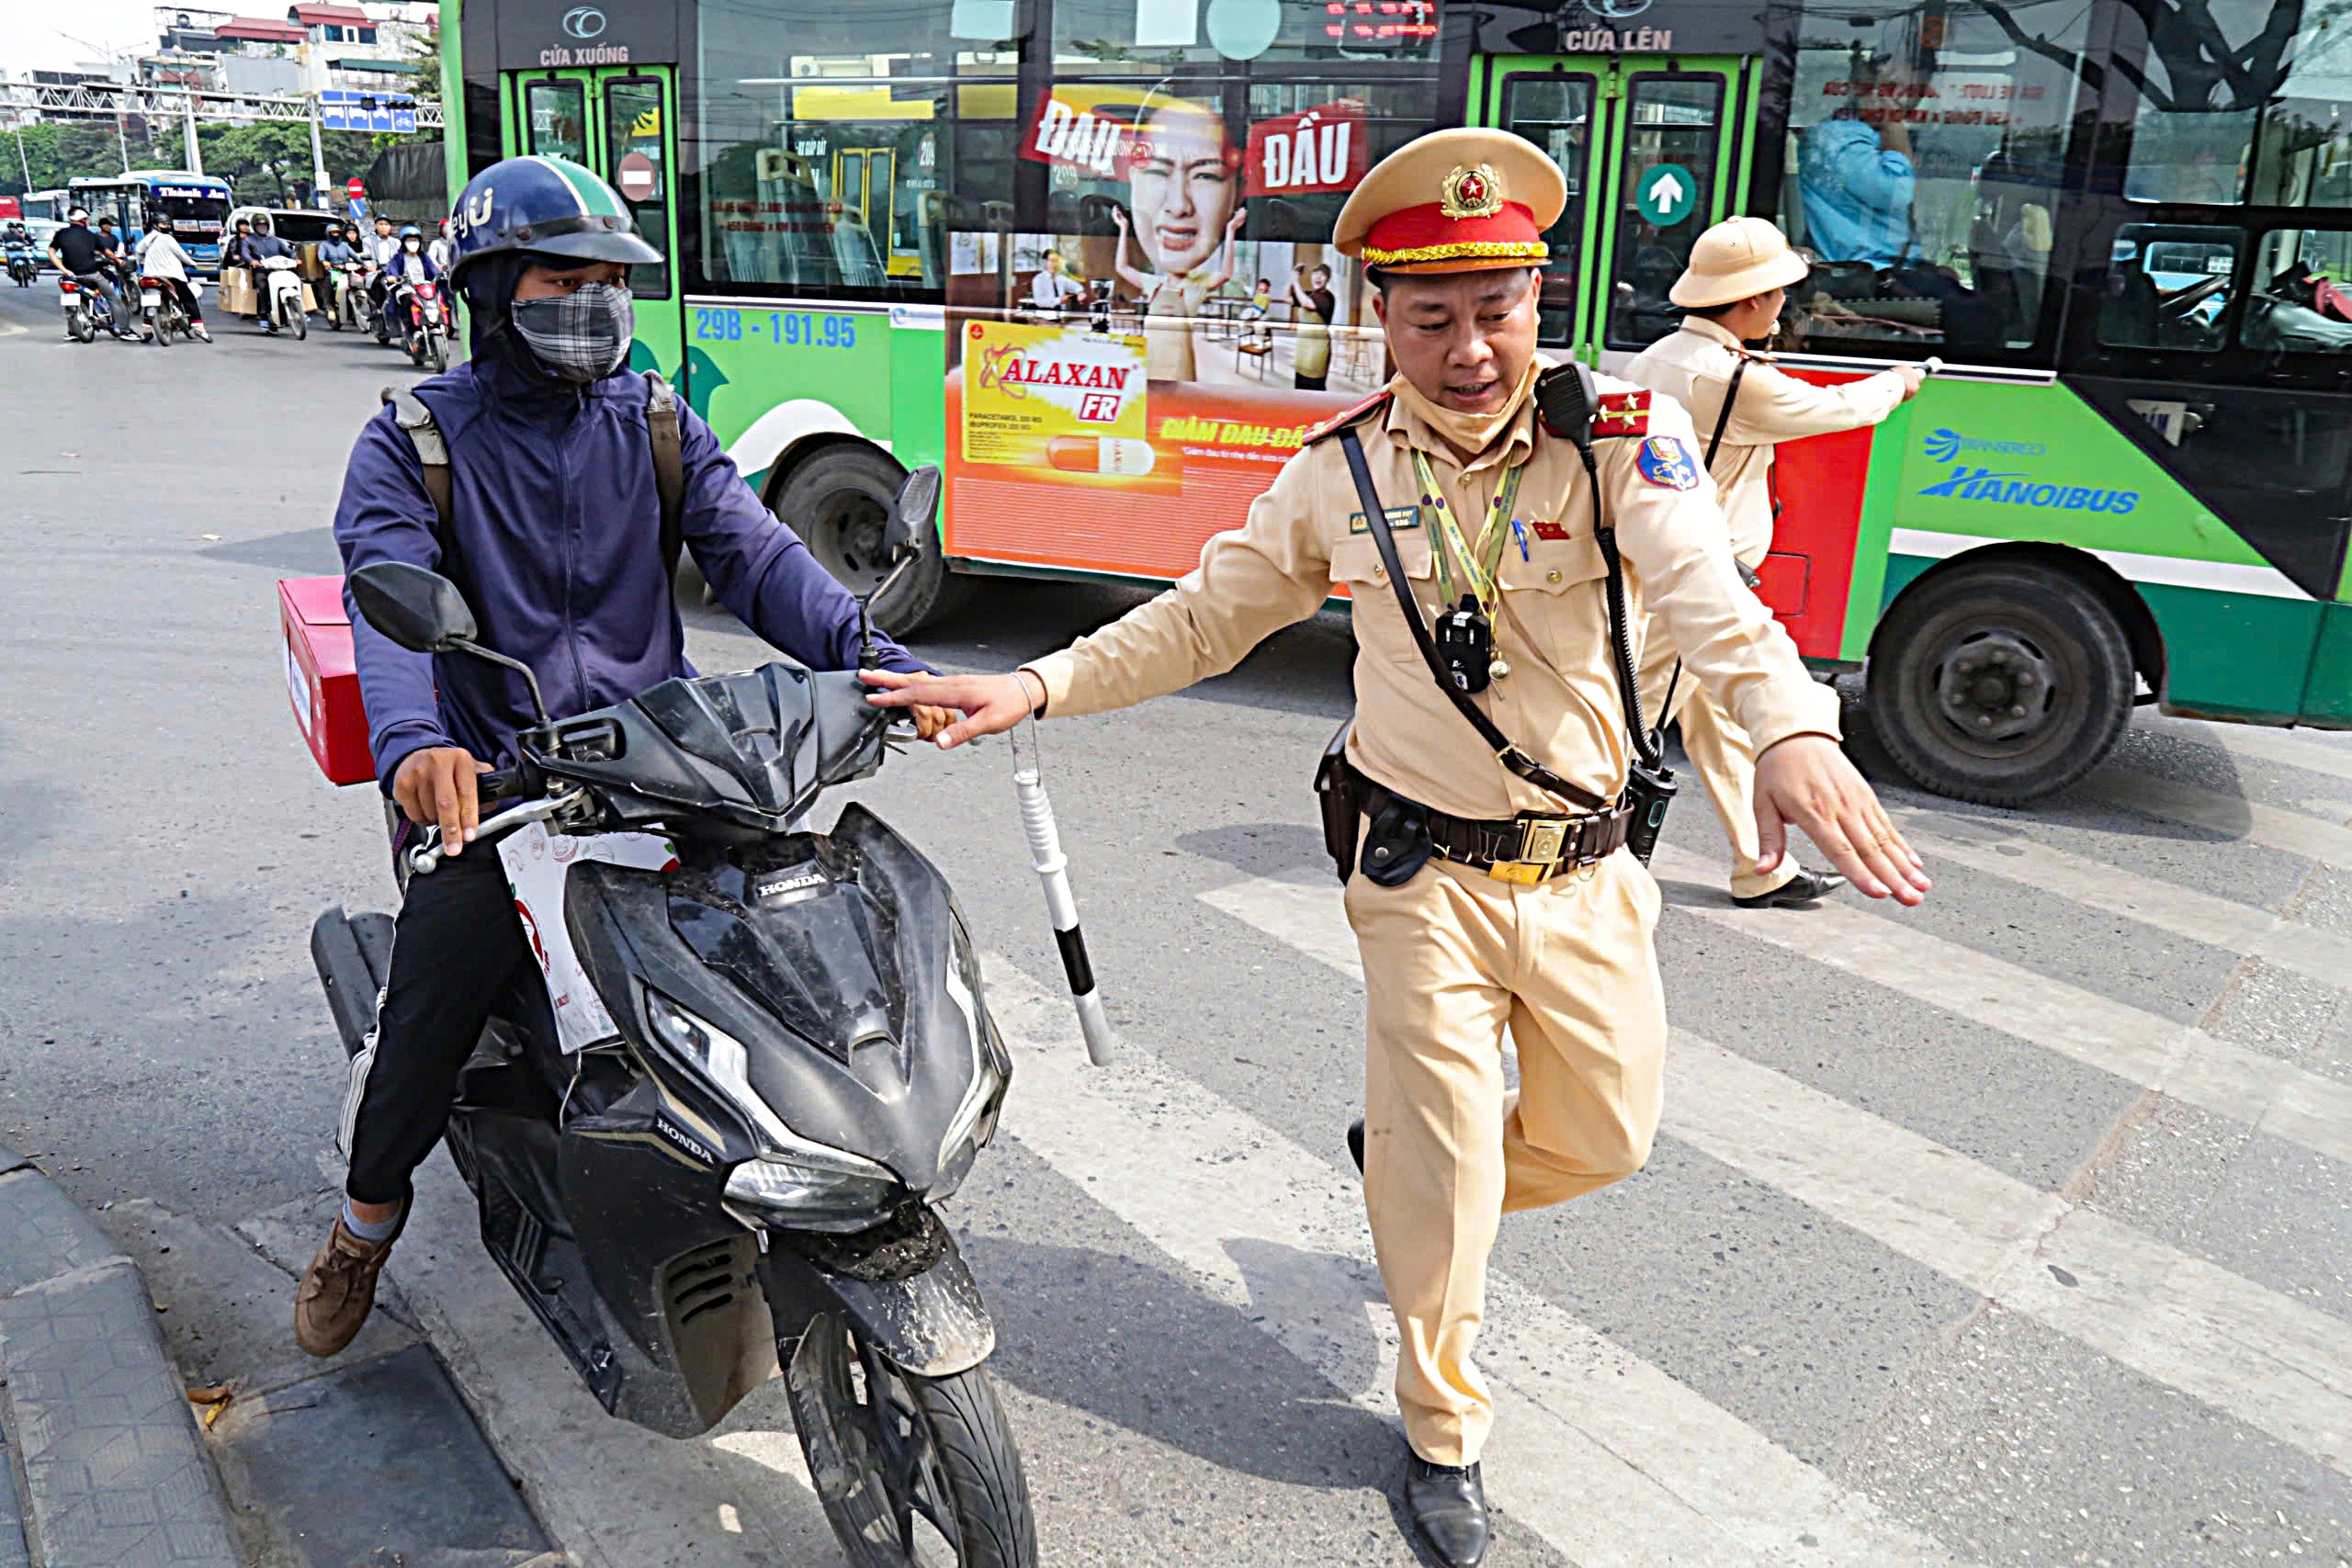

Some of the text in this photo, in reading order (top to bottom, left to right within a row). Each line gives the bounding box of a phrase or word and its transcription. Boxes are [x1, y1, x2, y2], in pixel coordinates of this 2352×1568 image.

[1566, 23, 1672, 51] CỬA LÊN
[540, 41, 629, 66] CỬA XUỐNG
[1035, 98, 1122, 177] ĐAU
[1262, 111, 1351, 188] ĐẦU
[159, 186, 202, 198] Thành
[696, 308, 742, 341] 29B
[770, 313, 855, 348] 191.95
[1000, 357, 1130, 390] ALAXAN
[1081, 395, 1118, 421] FR
[1160, 415, 1218, 442] GIẢM
[1918, 466, 2141, 514] HANOIBUS
[758, 874, 827, 897] HONDA
[657, 1116, 714, 1165] HONDA
